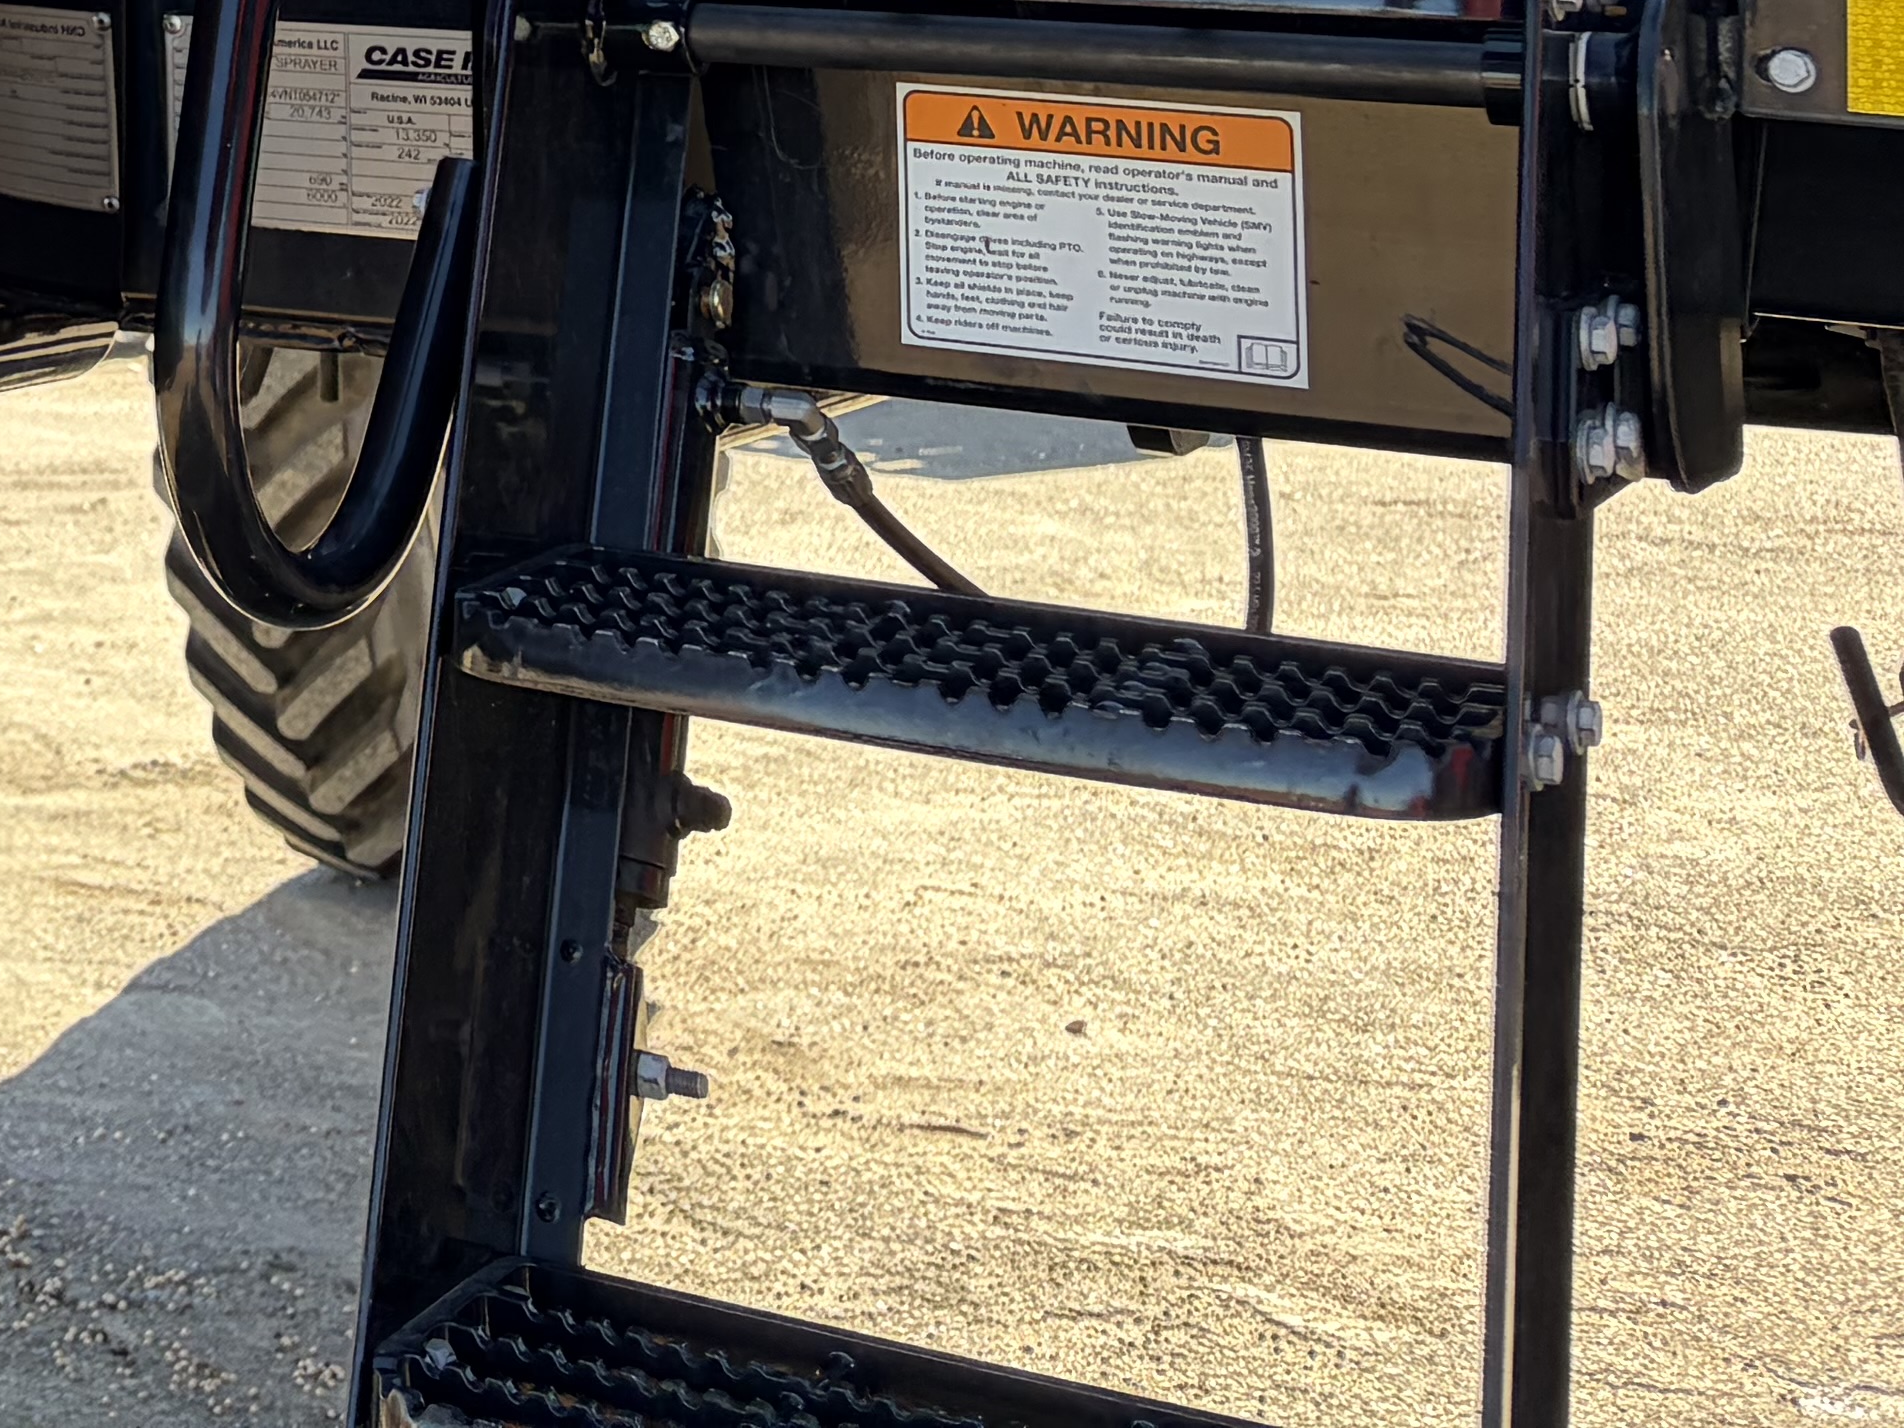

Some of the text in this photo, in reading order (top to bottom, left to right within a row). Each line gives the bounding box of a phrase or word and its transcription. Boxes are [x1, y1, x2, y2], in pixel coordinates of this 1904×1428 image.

[317, 40, 339, 52] LLC
[274, 56, 338, 72] SPRAYER
[364, 45, 457, 71] CASE
[371, 92, 411, 105] Racine,
[1016, 110, 1222, 157] WARNING
[397, 147, 421, 161] 242
[913, 147, 1279, 189] Before operating machine, read operator's manual and
[1006, 171, 1032, 183] ALL
[1036, 173, 1091, 188] SAFETY
[944, 181, 980, 191] manual
[1151, 198, 1189, 209] service
[1108, 208, 1128, 218] Use
